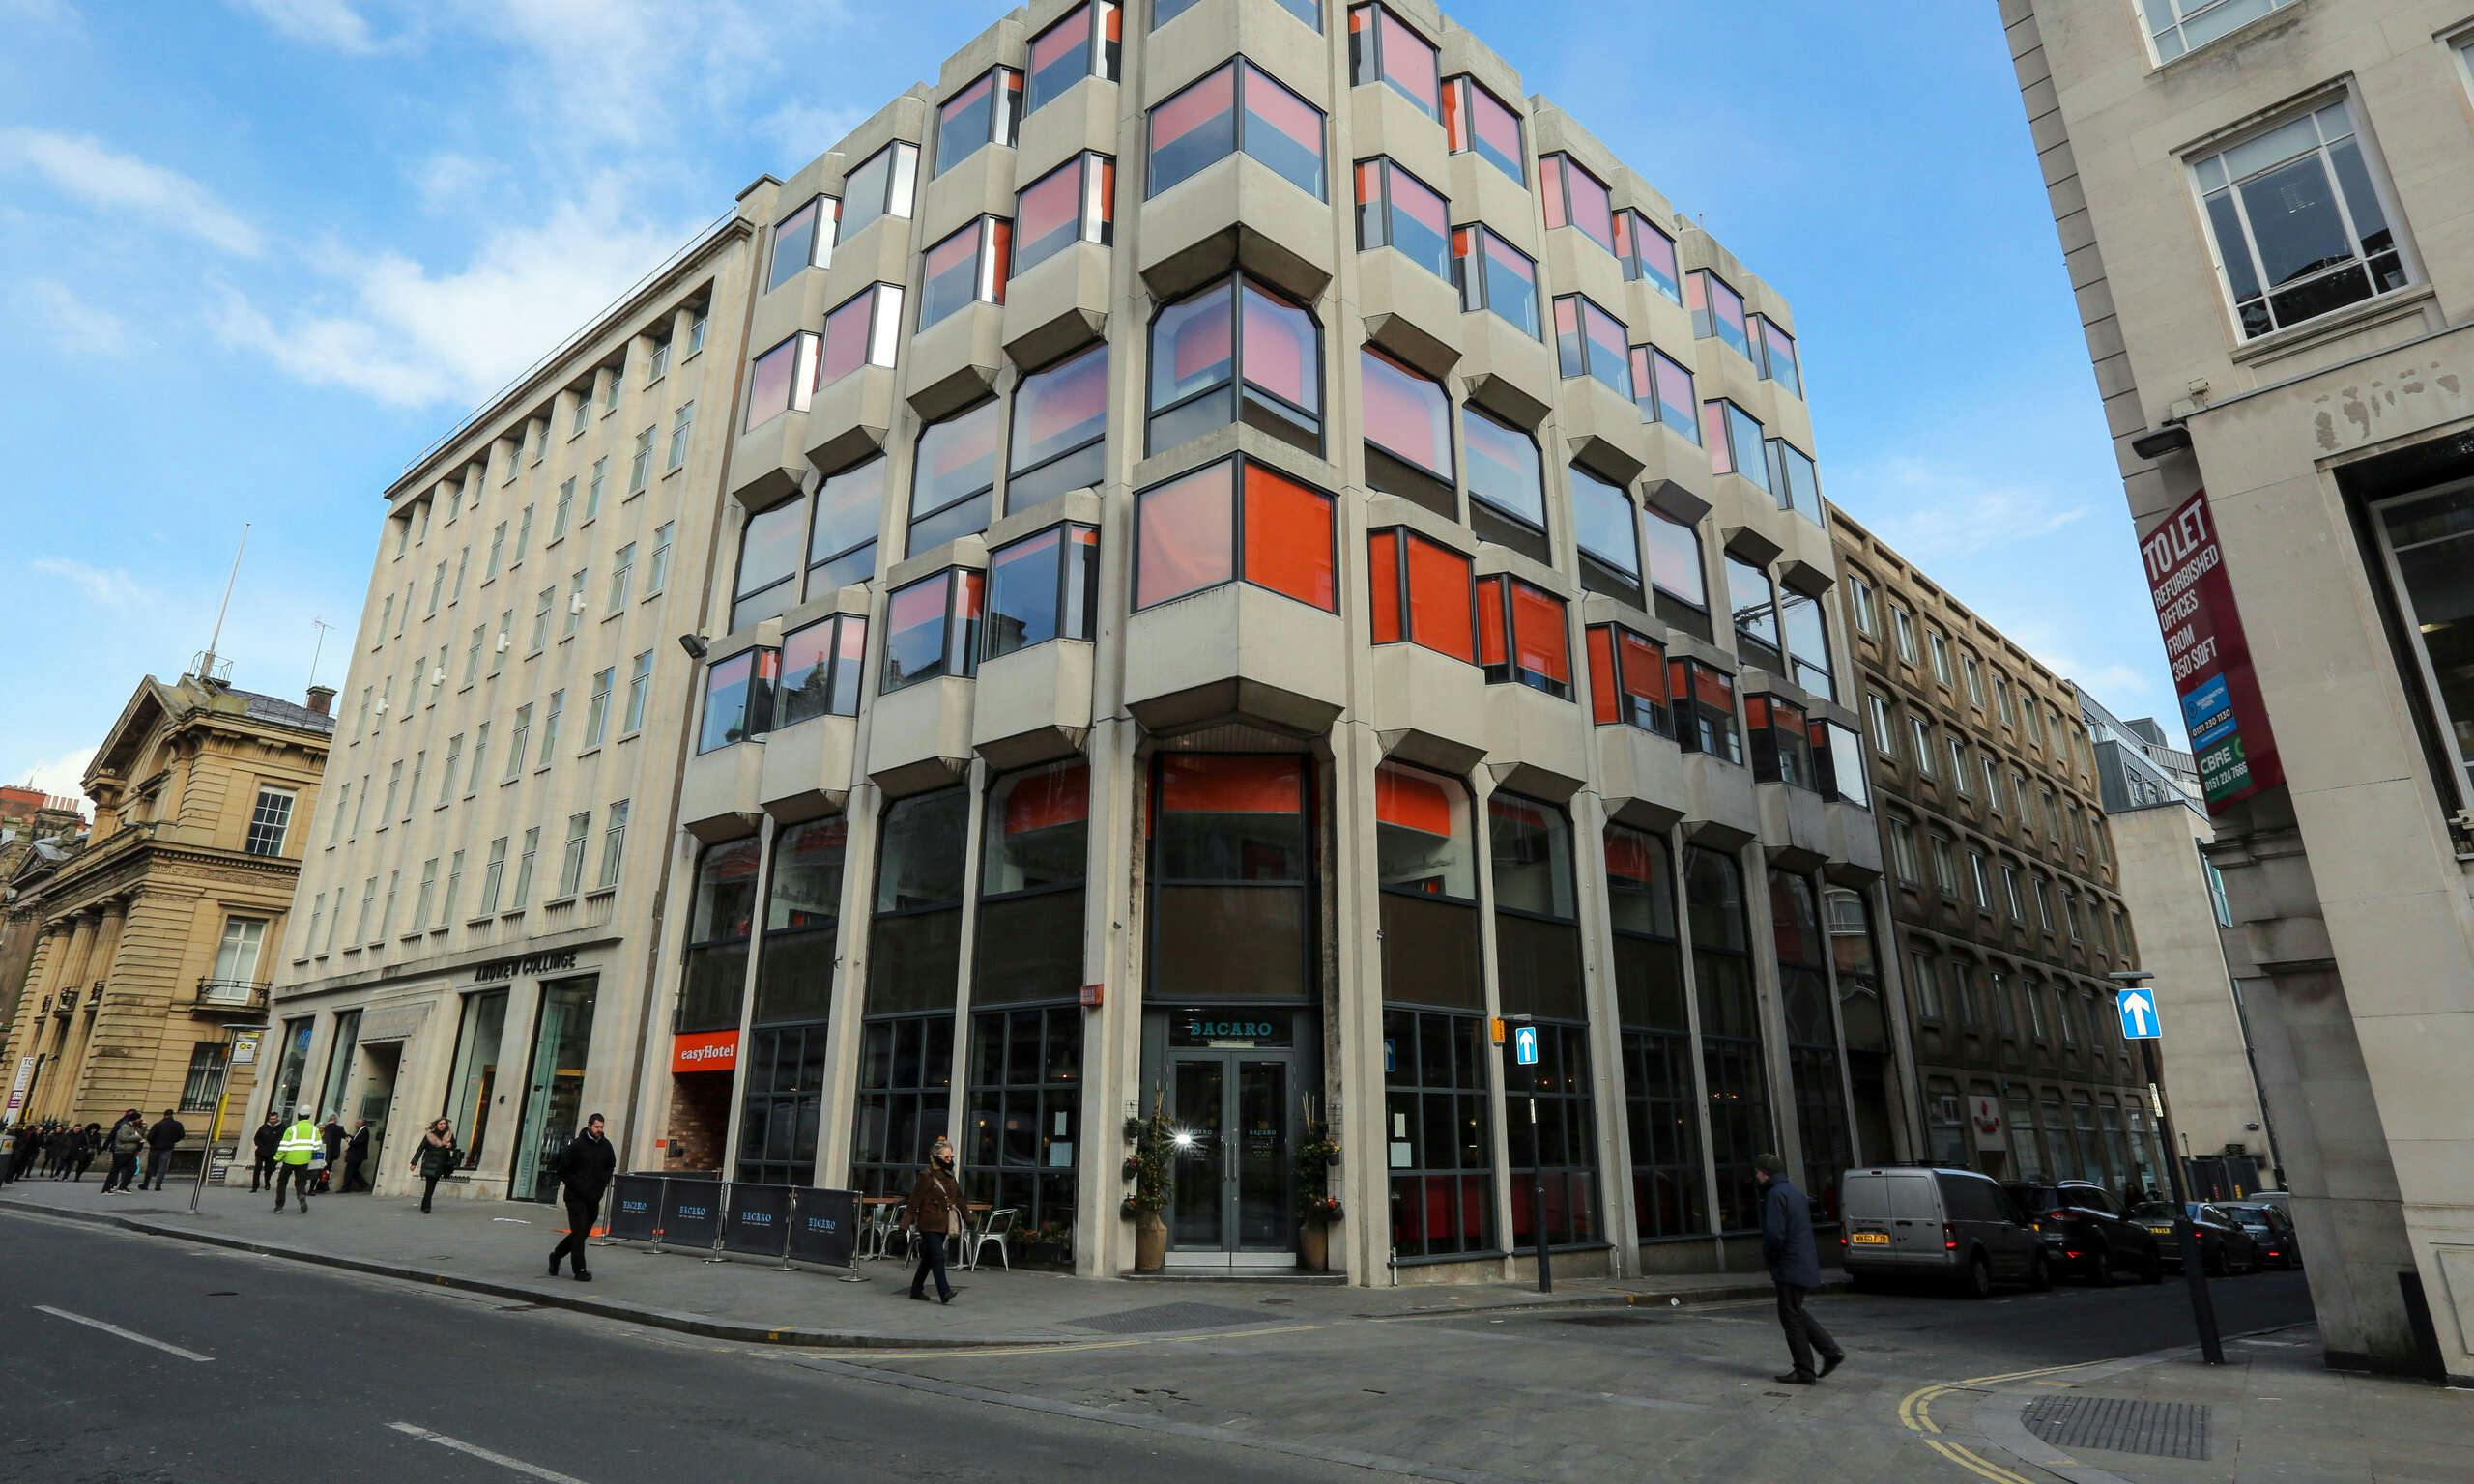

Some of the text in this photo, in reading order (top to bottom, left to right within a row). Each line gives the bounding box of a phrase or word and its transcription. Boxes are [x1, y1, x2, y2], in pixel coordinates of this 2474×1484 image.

[2143, 499, 2207, 581] TO LET
[2154, 544, 2219, 610] REFURBISHED
[2160, 588, 2199, 632] OFFICES
[2167, 623, 2196, 659] FROM
[2172, 636, 2217, 682] 350 SQFT
[2192, 723, 2205, 737] 0151
[2205, 717, 2217, 730] 230
[2217, 708, 2231, 724] 1130
[2200, 746, 2232, 774] CBRE
[2204, 776, 2220, 792] 0151
[2219, 769, 2233, 785] 224
[475, 950, 578, 982] ANDREW COLLINGE
[1191, 1021, 1273, 1037] BACARO
[681, 1043, 734, 1062] easyHotel
[742, 1211, 772, 1223] BACARO
